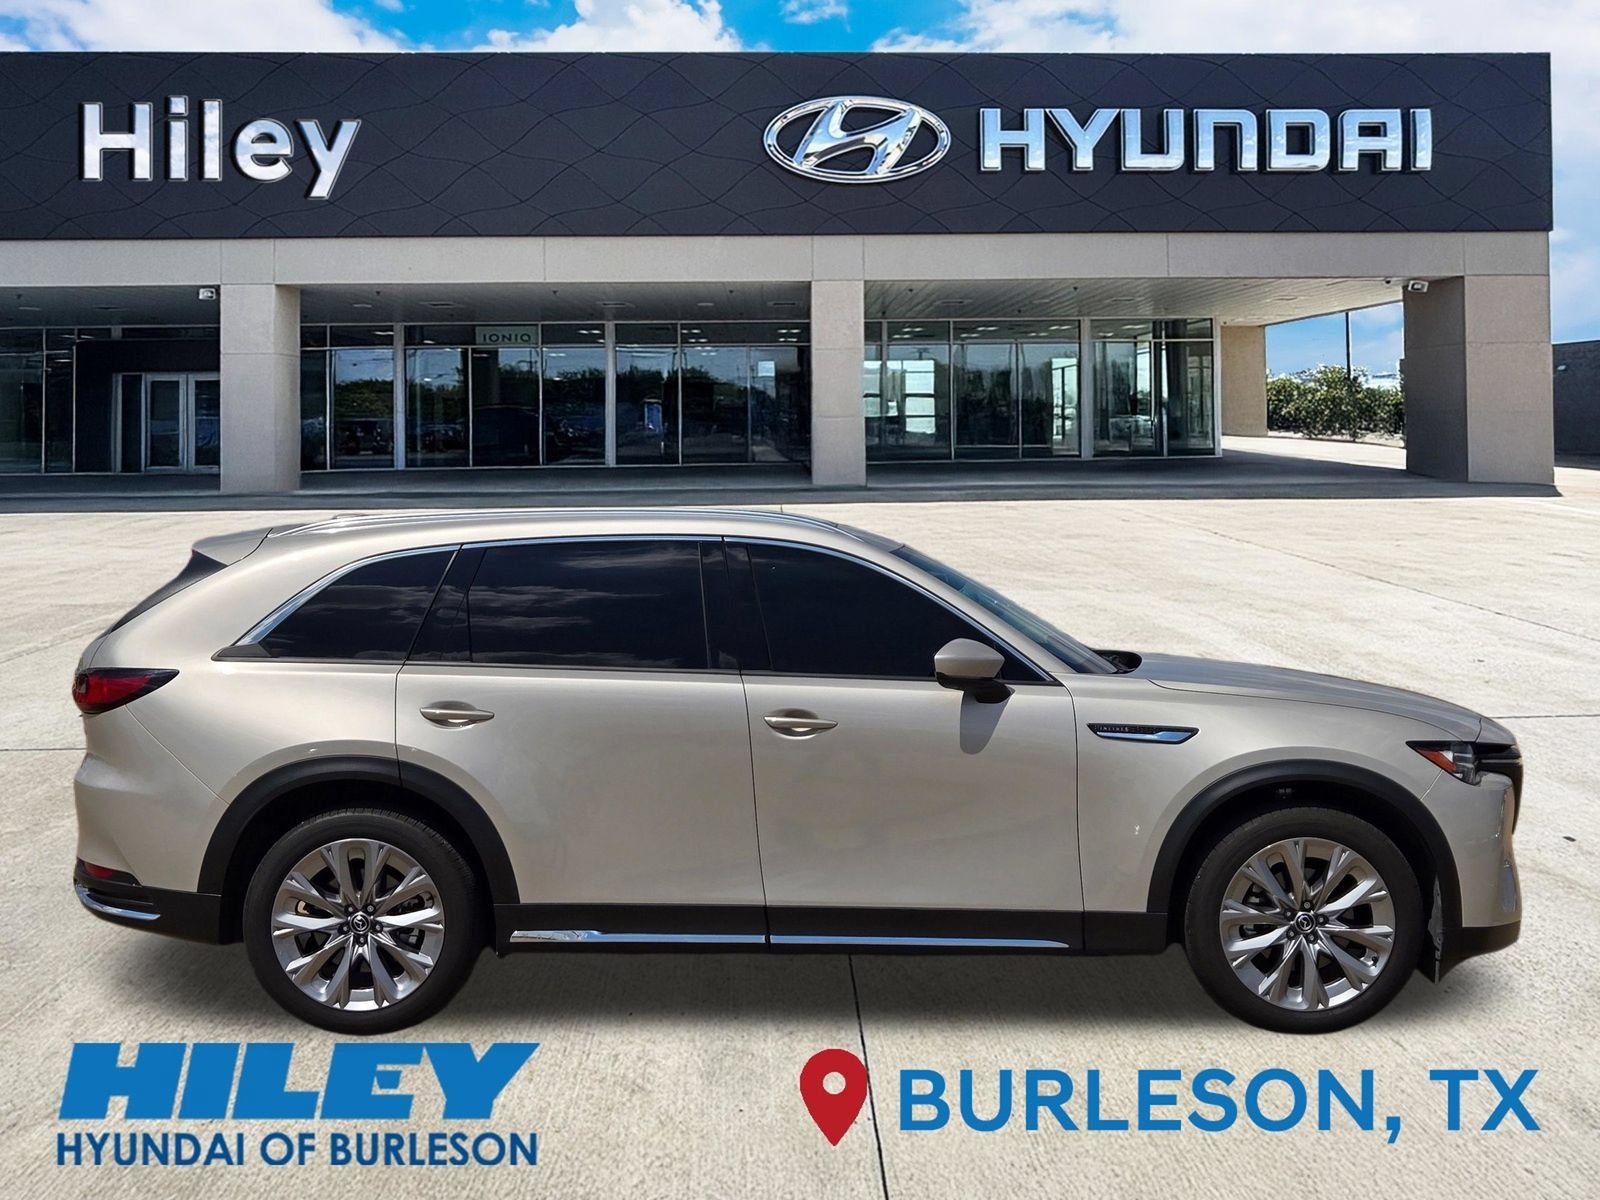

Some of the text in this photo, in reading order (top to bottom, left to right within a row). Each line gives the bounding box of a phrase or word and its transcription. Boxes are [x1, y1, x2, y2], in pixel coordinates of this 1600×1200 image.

[82, 95, 362, 200] Hiley
[979, 107, 1433, 172] HYUNDAI
[483, 332, 532, 343] IONIQ
